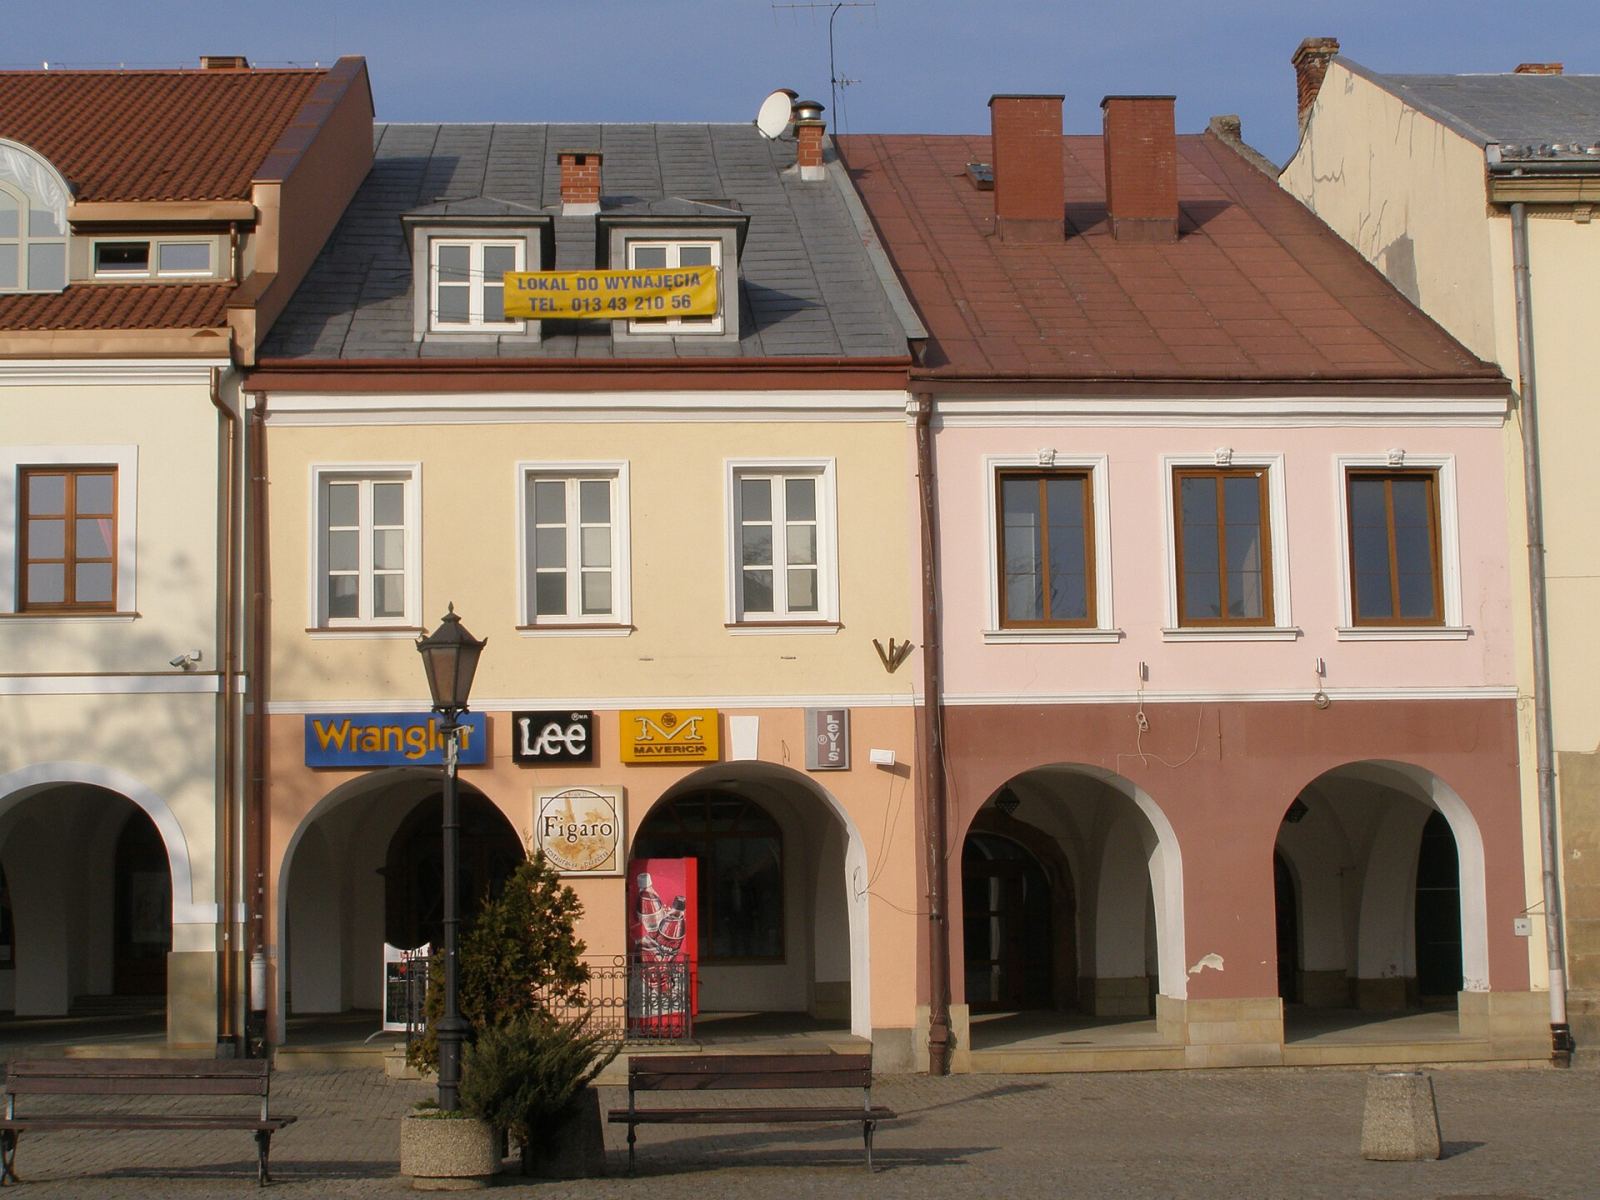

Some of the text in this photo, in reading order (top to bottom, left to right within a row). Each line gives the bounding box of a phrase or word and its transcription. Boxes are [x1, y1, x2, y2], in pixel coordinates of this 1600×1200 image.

[518, 272, 700, 291] LOKAL DO WYNAJĘCIA
[529, 294, 692, 312] TEL. 013 43 210 56
[518, 718, 586, 755] Lee
[634, 745, 707, 754] MAVERICK
[544, 816, 612, 843] Figaro
